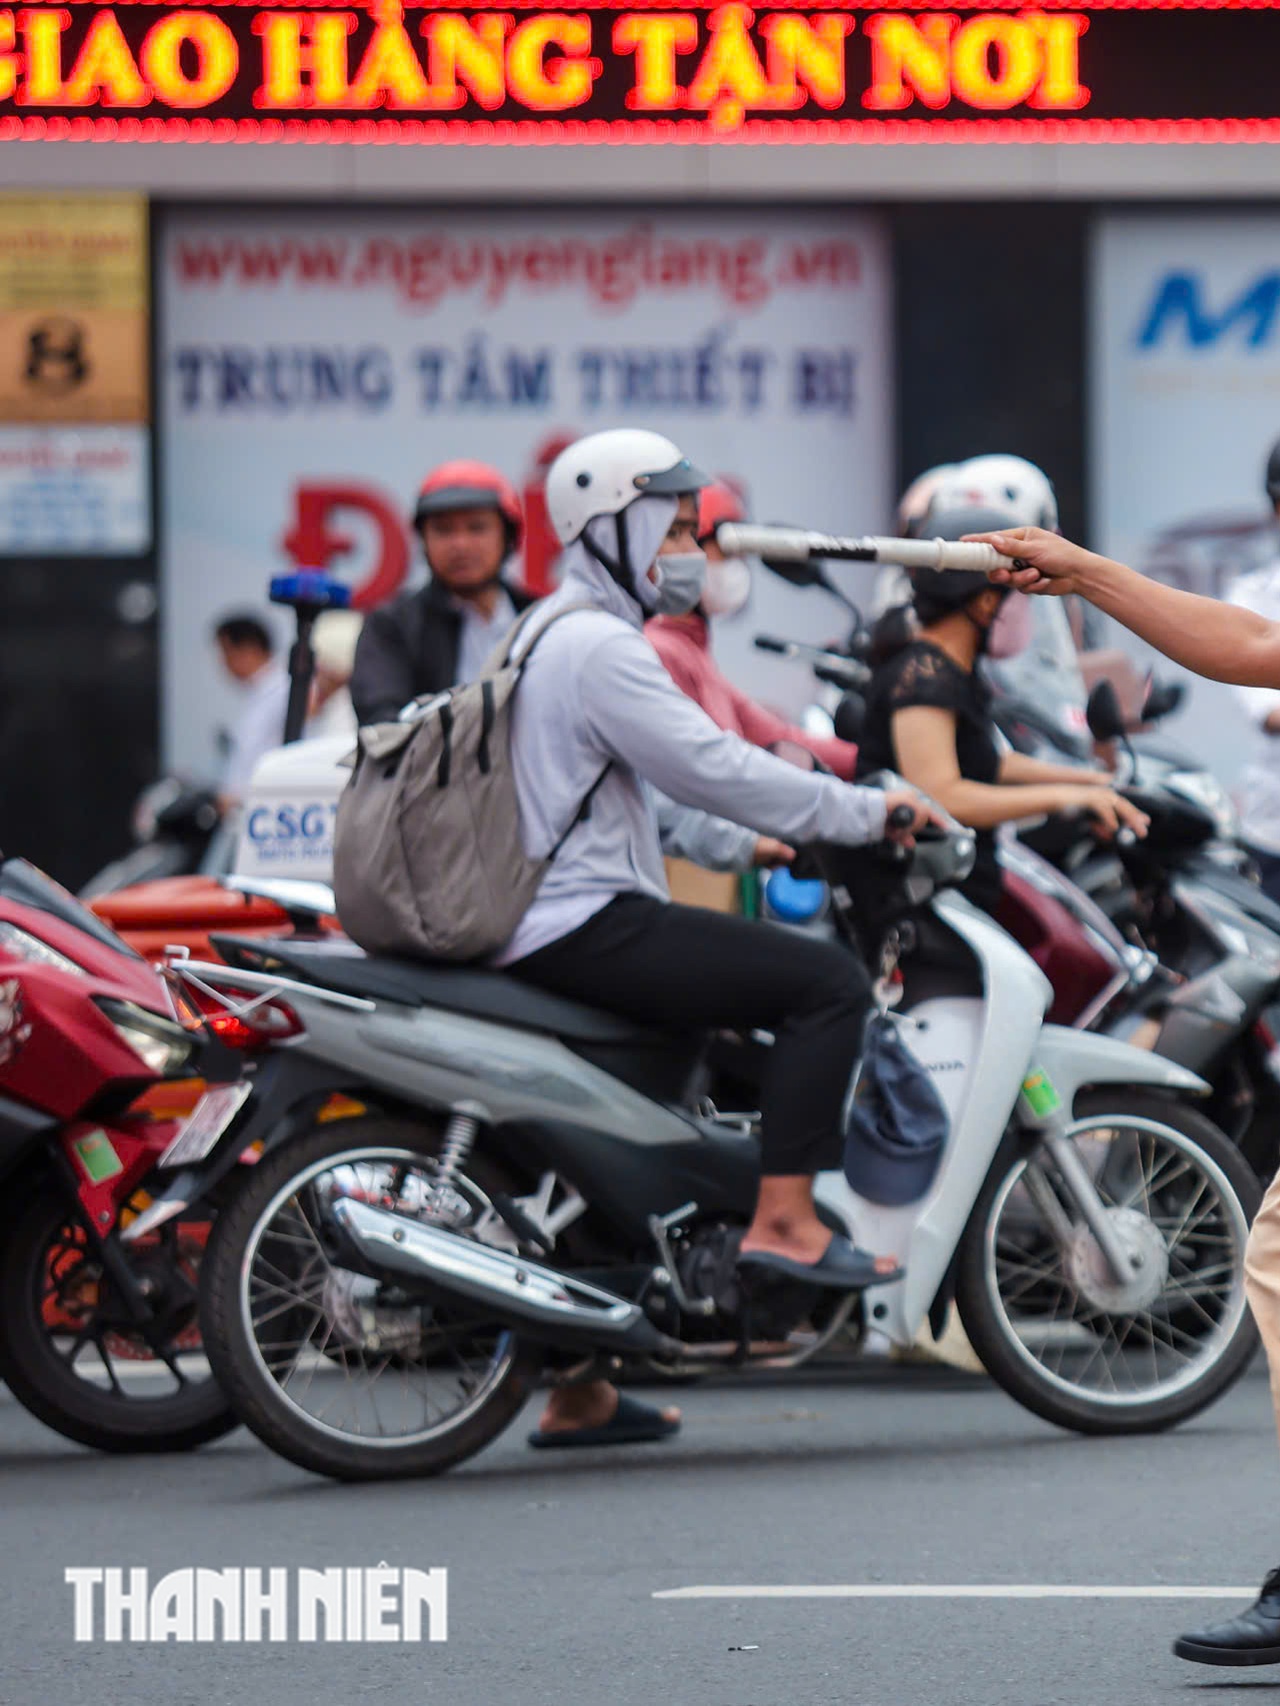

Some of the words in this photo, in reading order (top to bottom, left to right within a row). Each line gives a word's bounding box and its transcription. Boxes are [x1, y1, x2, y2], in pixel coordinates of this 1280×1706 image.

[0, 9, 239, 108] IAO
[252, 0, 603, 110] HÀNG
[612, 2, 855, 128] TẬN
[862, 8, 1091, 110] NƠI
[177, 228, 861, 314] www.nguyengiang.vn
[176, 346, 394, 411] TRUNG
[415, 330, 552, 409] TÂM
[578, 322, 770, 409] THIẾT
[248, 804, 337, 841] CSG
